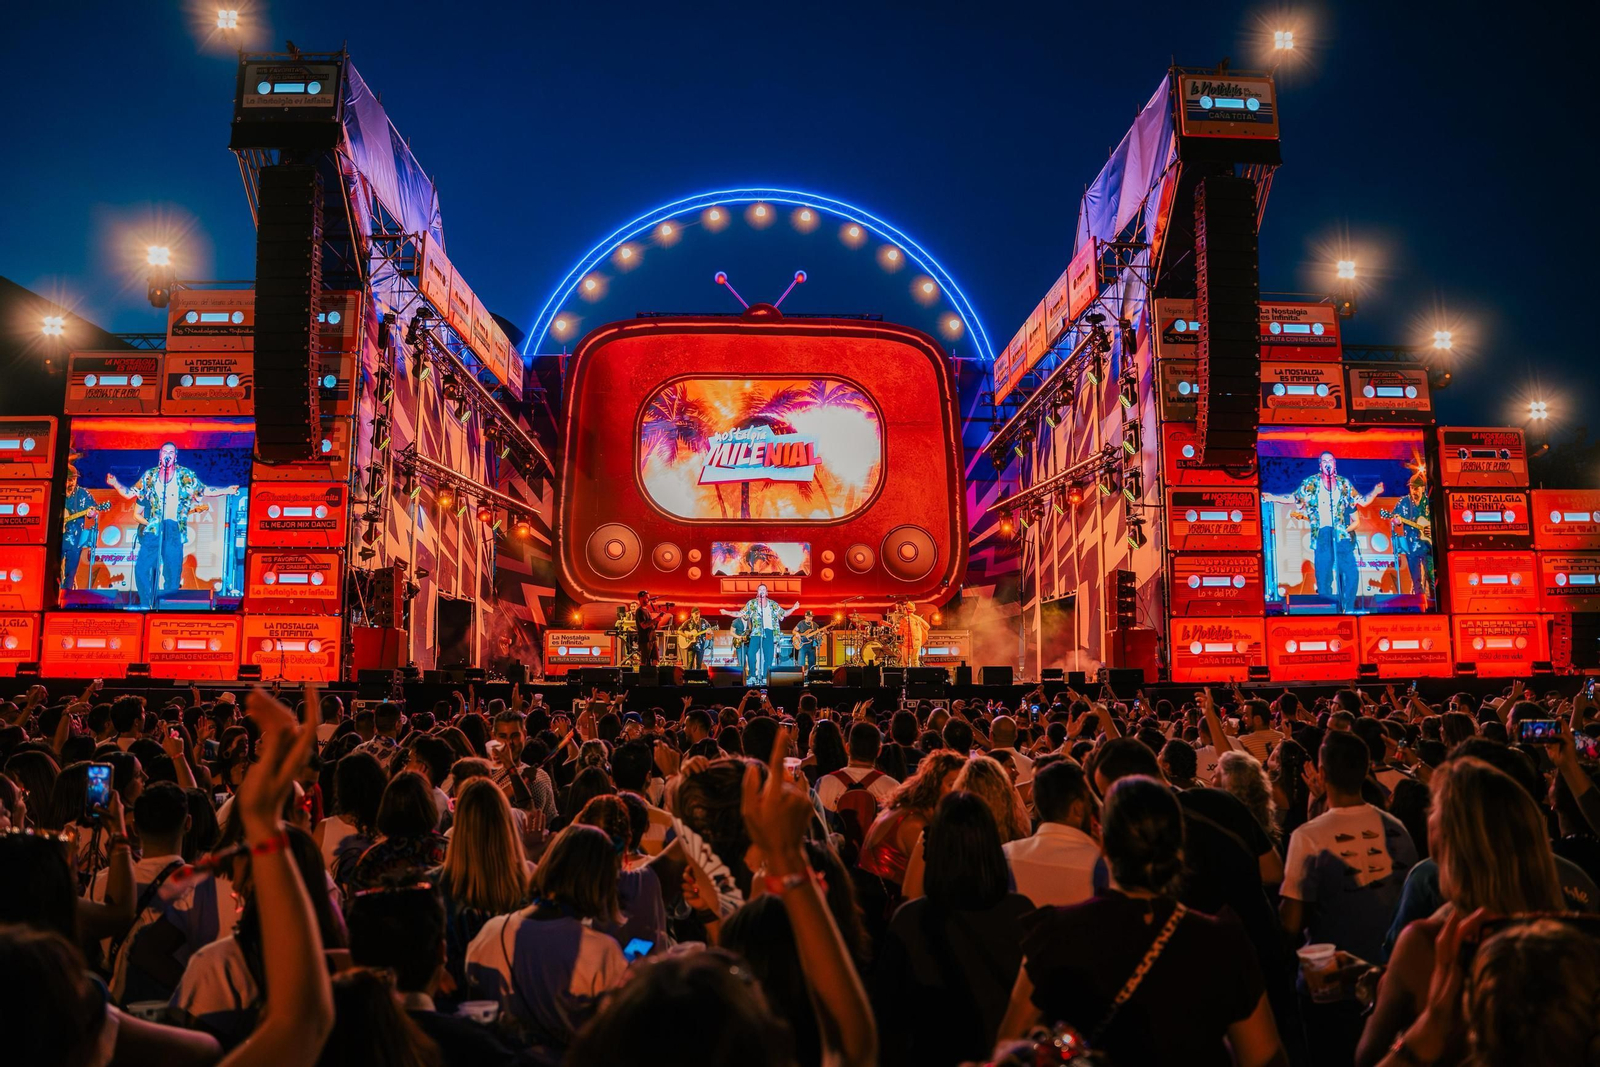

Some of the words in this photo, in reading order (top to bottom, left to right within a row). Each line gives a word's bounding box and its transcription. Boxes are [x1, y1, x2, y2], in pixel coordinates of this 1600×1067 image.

[1208, 110, 1231, 120] CAÑA
[1232, 112, 1257, 121] TOTAL
[1271, 308, 1308, 317] Nostalgia
[714, 424, 767, 448] nostalgia
[702, 441, 822, 468] MILENIAL
[1452, 494, 1465, 502] LA
[1467, 494, 1522, 502] NOSTALGIA
[1452, 502, 1465, 510] ES
[1467, 502, 1507, 510] INFINITA
[101, 554, 126, 566] mejor
[252, 587, 262, 596] La
[263, 587, 298, 597] Nostalgia
[308, 587, 335, 596] infinita
[1197, 589, 1206, 598] Lo
[1213, 588, 1225, 597] del
[1225, 588, 1239, 597] POP
[264, 622, 274, 630] LA
[275, 622, 319, 630] NOSTALGIA
[1460, 620, 1475, 628] LA
[1475, 620, 1536, 628] NOSTALGIA
[269, 629, 280, 637] ES
[280, 629, 314, 637] INFINITA
[1468, 627, 1483, 635] ES
[1484, 627, 1529, 635] INFINITA
[161, 653, 193, 661] FLIPARLO
[1198, 655, 1220, 664] CAÑA
[1221, 656, 1246, 664] TOTAL
